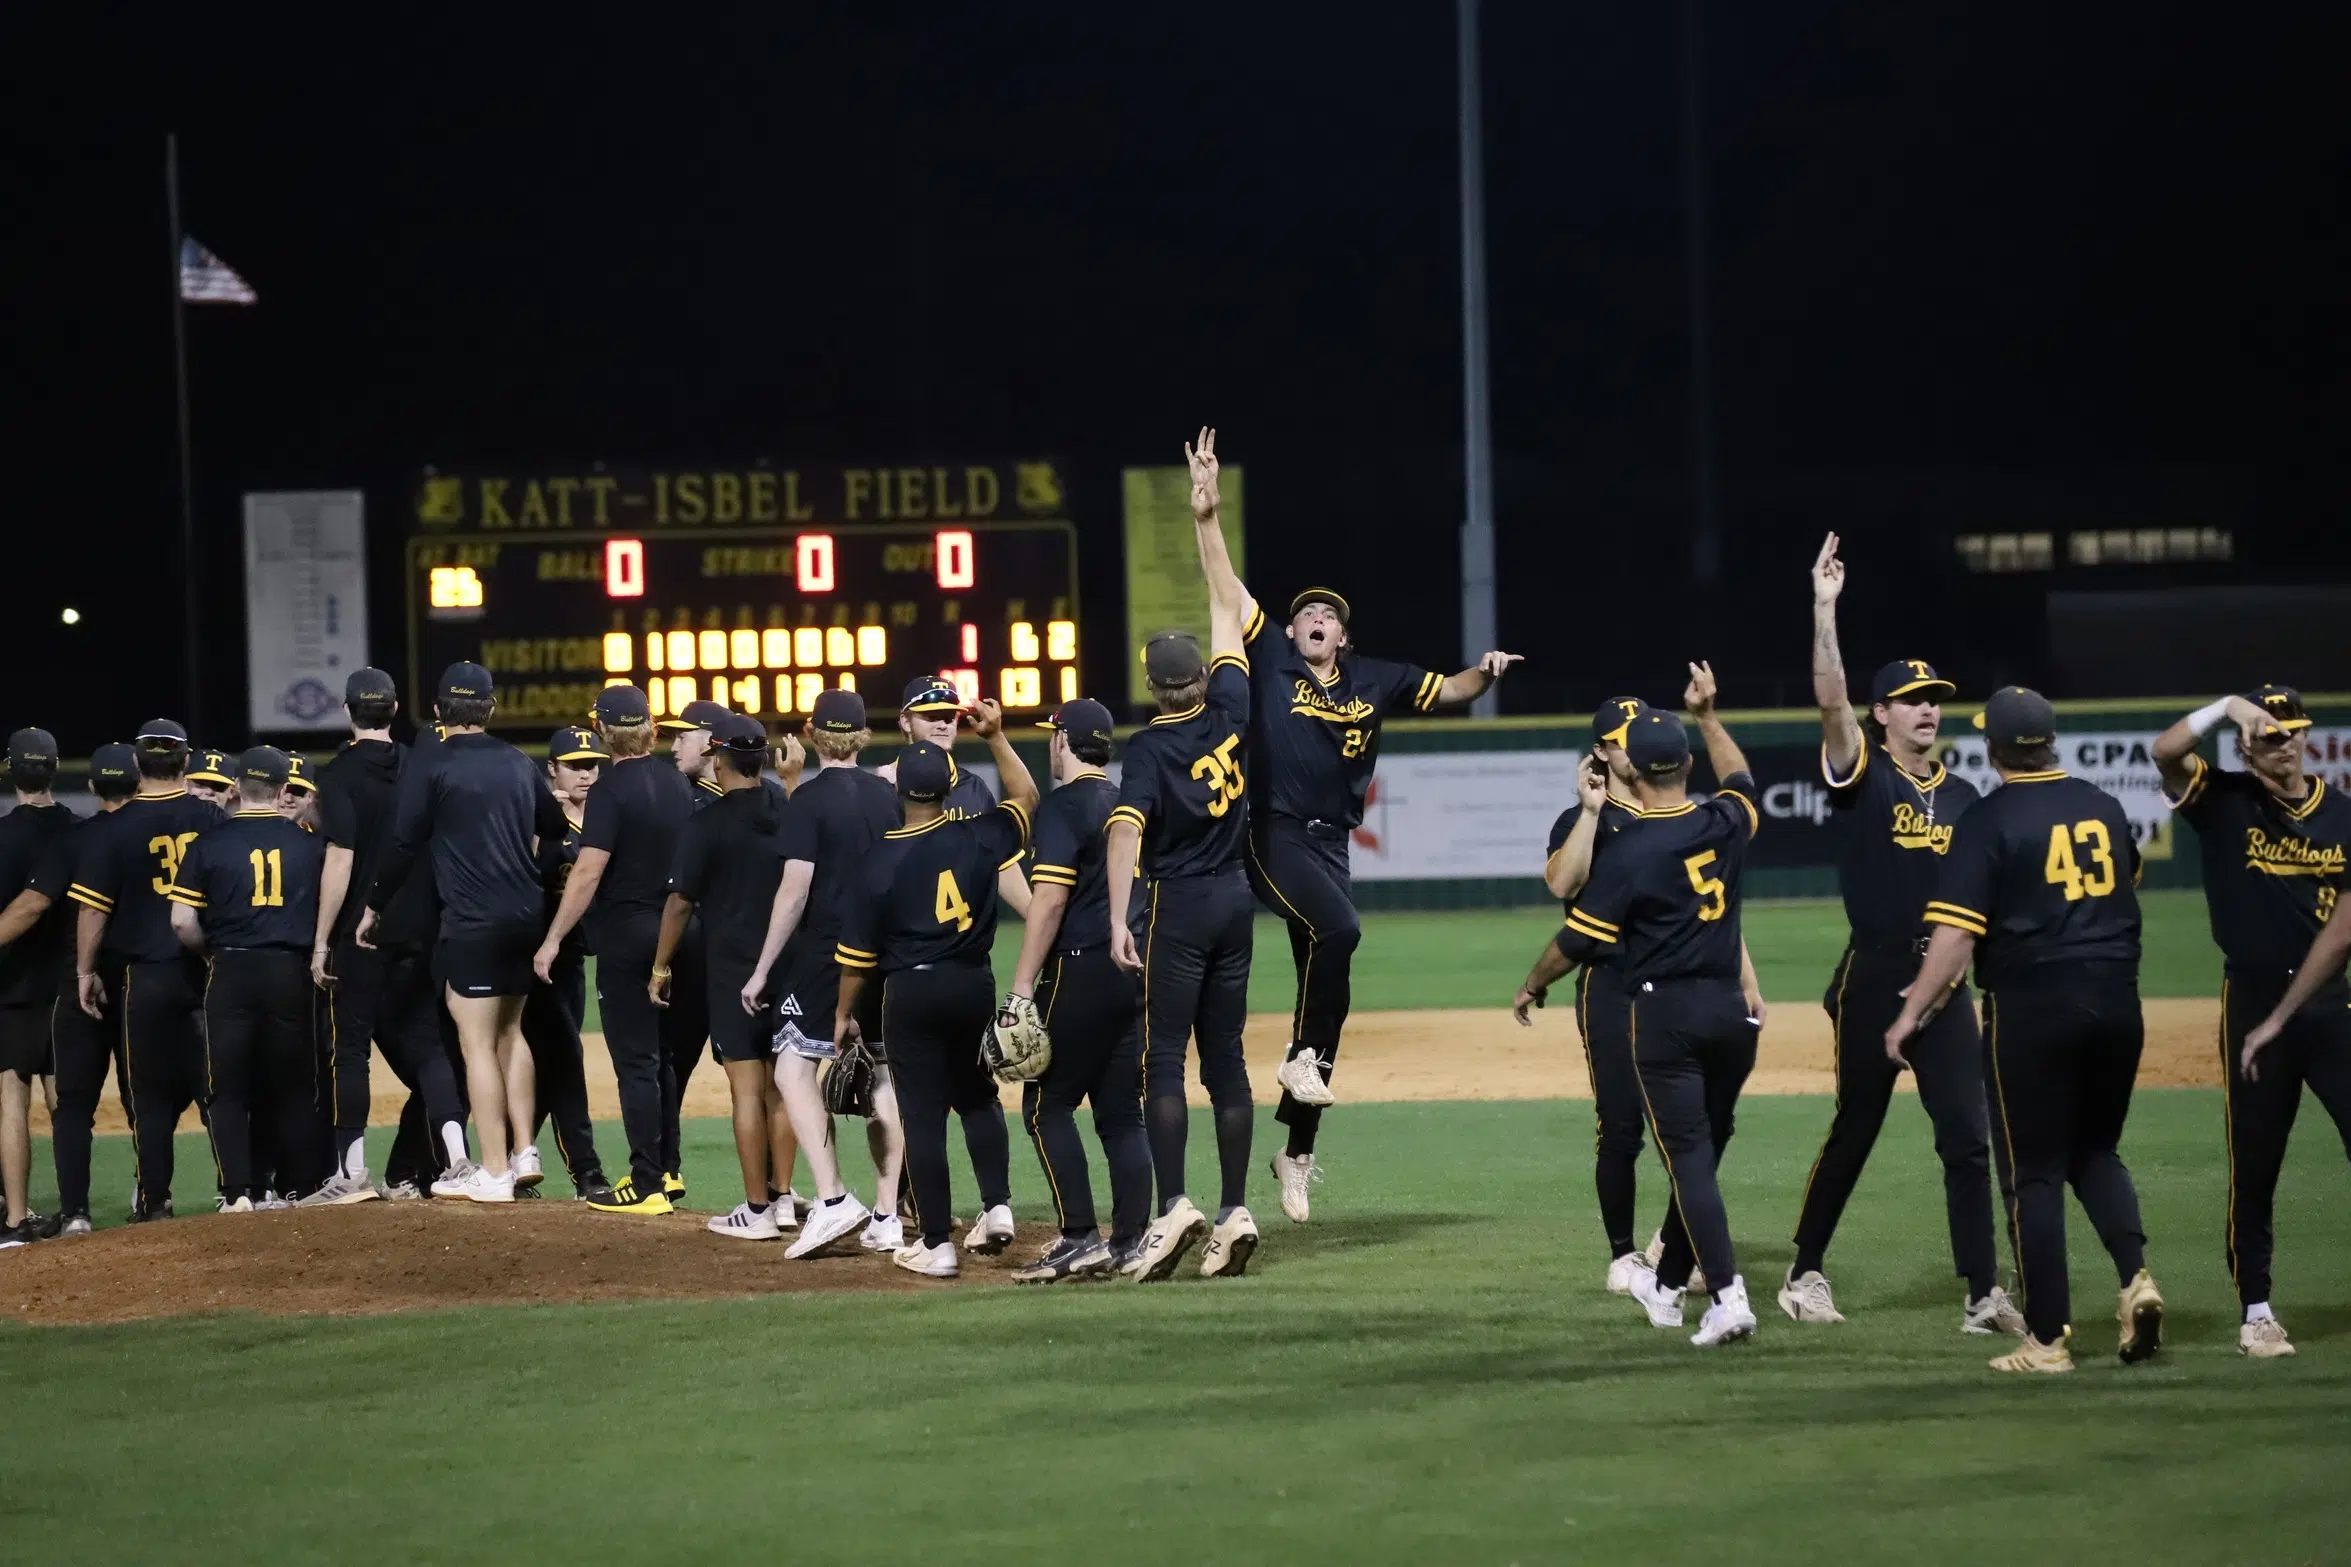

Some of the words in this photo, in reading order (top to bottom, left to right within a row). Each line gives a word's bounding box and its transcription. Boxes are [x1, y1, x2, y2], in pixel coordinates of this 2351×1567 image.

[480, 470, 814, 529] KATT-ISBEL
[842, 467, 1000, 519] FIELD
[605, 539, 643, 596] 0
[797, 535, 834, 591] 0
[936, 531, 974, 588] 0
[857, 626, 886, 665] 0
[961, 623, 978, 662] 1
[1047, 621, 1076, 661] 2
[1907, 660, 1930, 679] T
[450, 686, 476, 696] Bulldogs
[1619, 700, 1639, 720] T
[575, 731, 591, 749] T
[826, 720, 852, 730] Bulldogs
[205, 754, 223, 772] T
[288, 757, 304, 775] T
[1191, 733, 1245, 818] 35
[249, 848, 284, 907] 11
[2045, 818, 2116, 902] 43
[2246, 827, 2347, 878] Bulldogs
[935, 868, 973, 933] 4
[1684, 849, 1727, 922] 5
